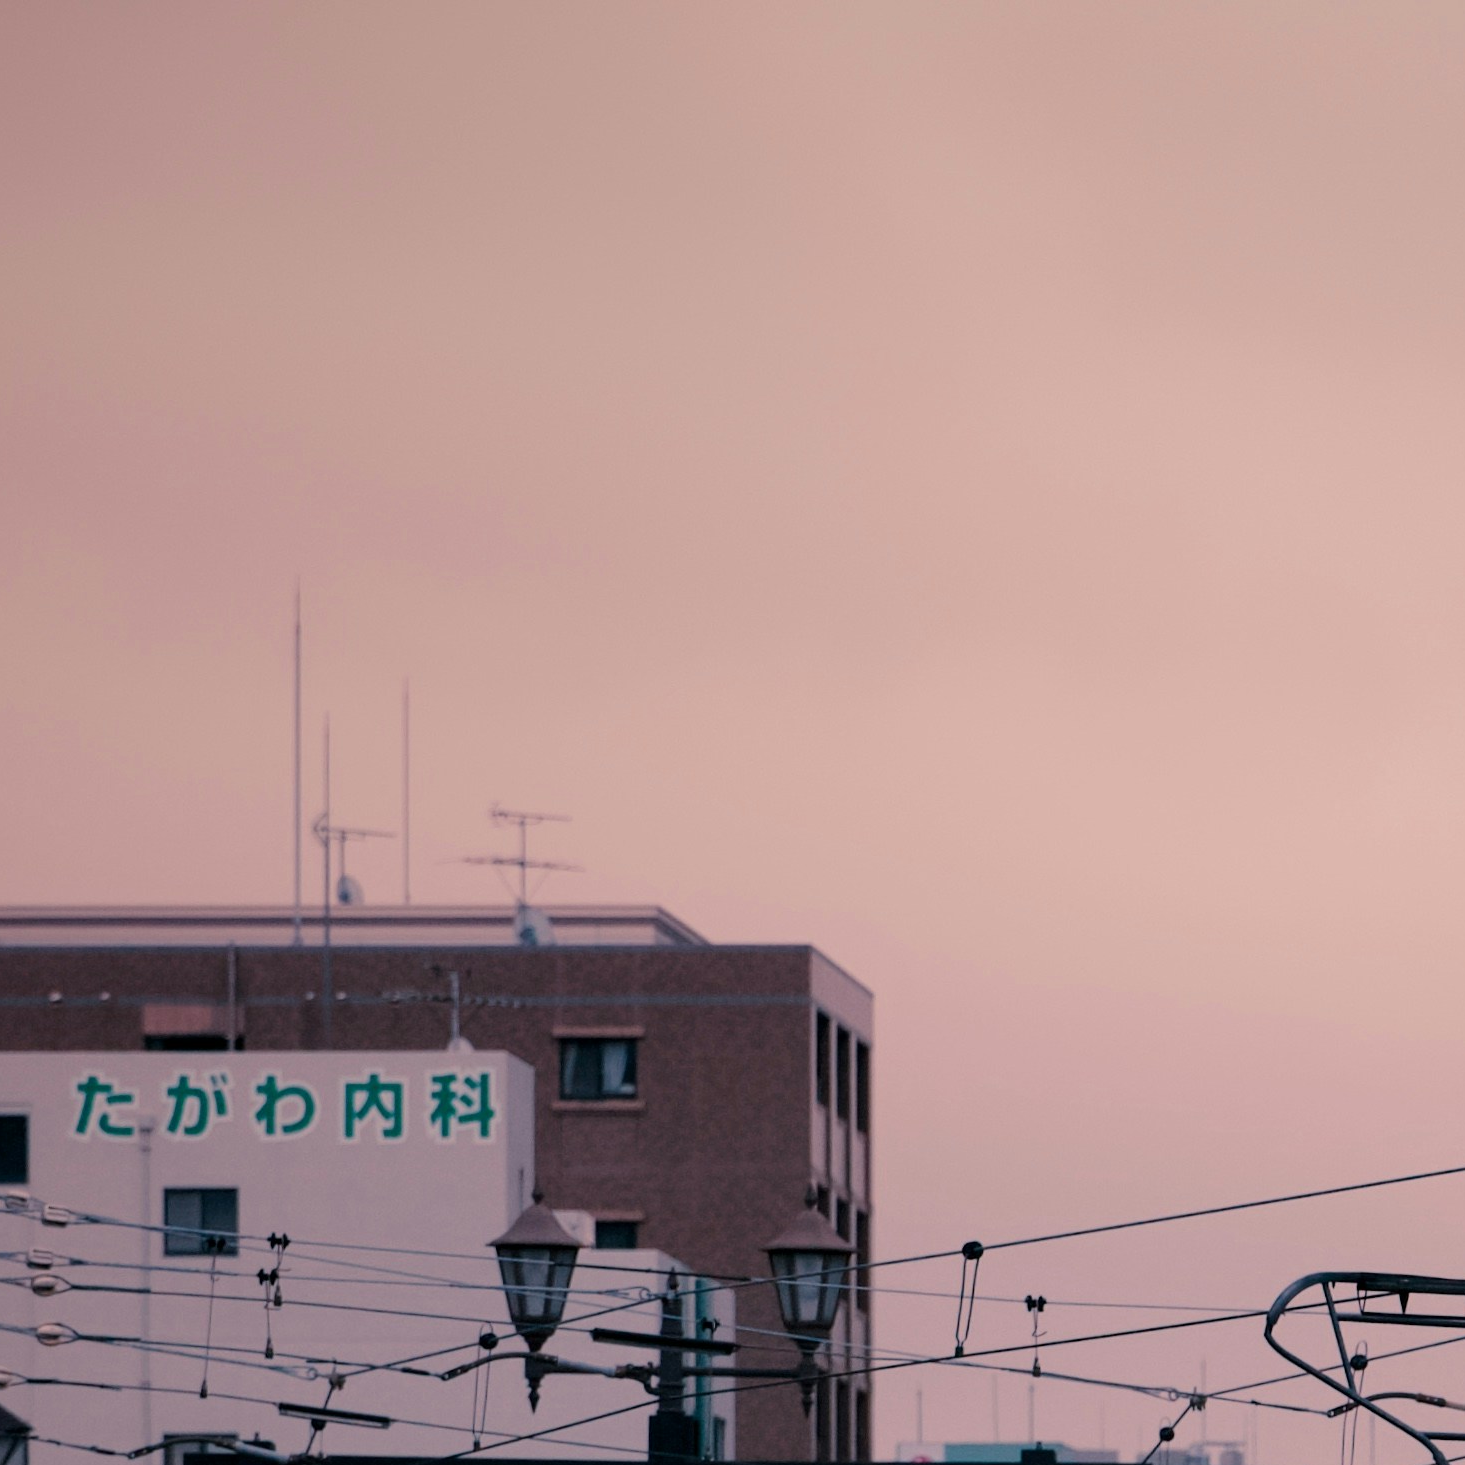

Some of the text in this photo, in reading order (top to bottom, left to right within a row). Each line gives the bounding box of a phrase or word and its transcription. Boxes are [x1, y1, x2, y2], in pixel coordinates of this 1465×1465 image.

[76, 1073, 493, 1138] たがわ内科
